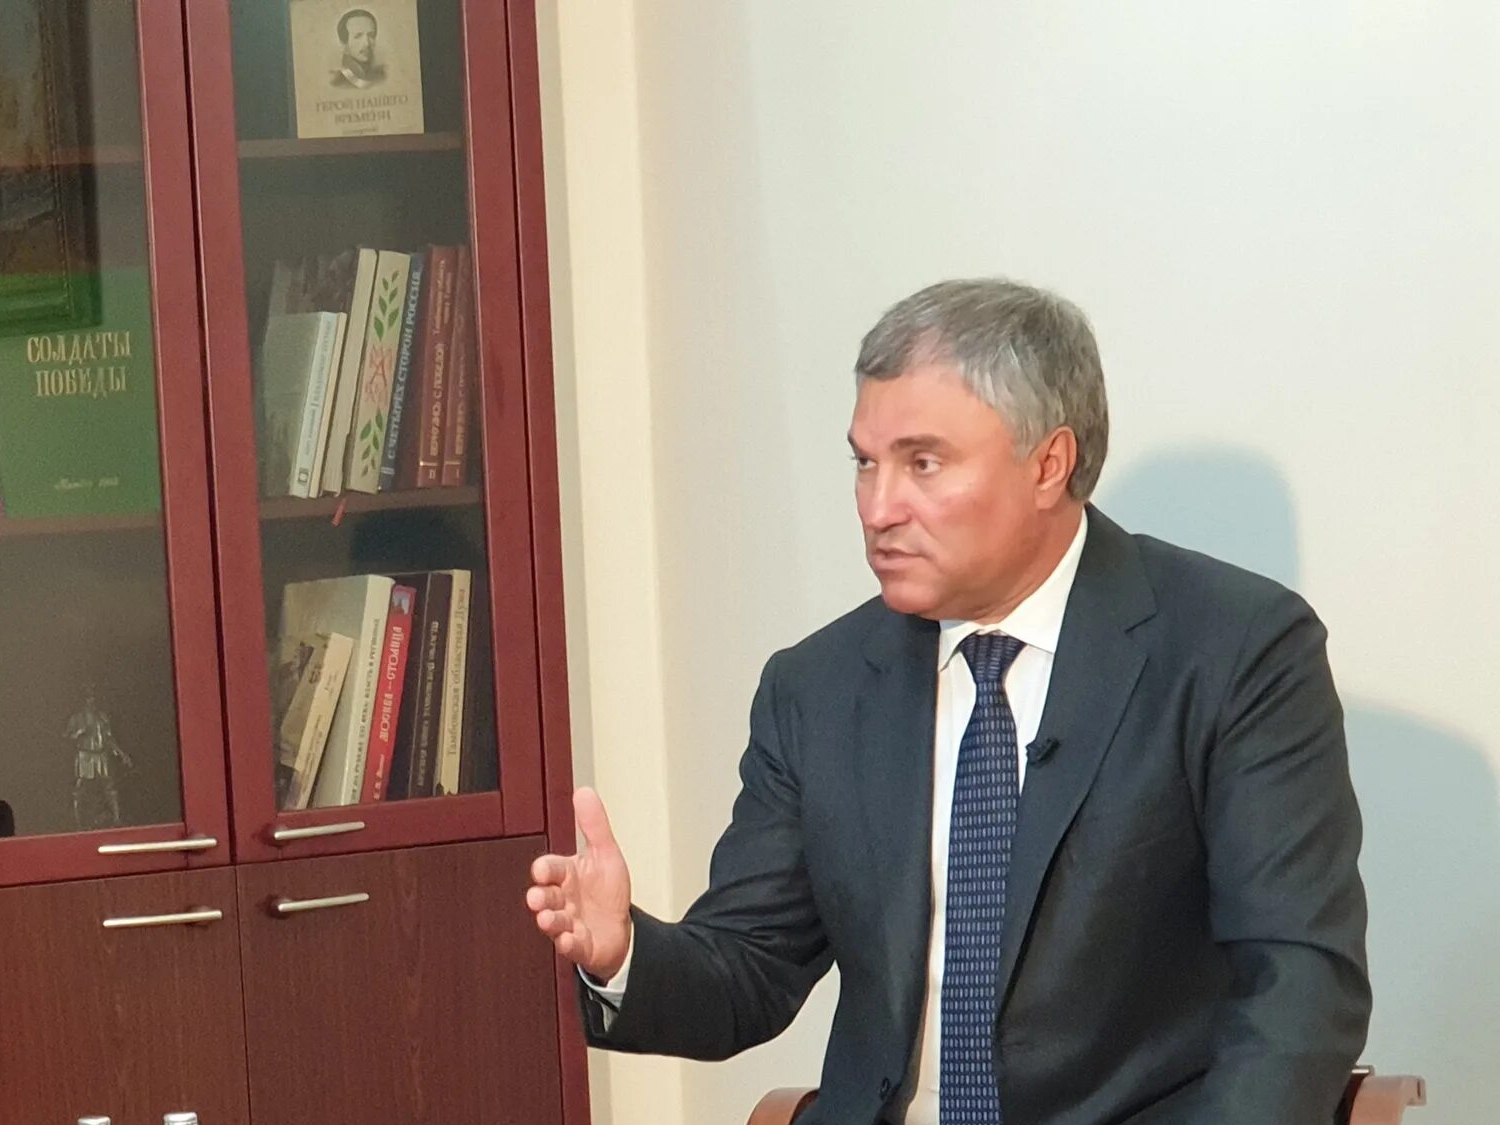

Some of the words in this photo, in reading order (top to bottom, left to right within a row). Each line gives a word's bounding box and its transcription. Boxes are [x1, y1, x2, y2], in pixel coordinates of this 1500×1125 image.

[27, 331, 132, 365] СОЛДАТЫ
[397, 327, 413, 381] СТОРОН
[35, 366, 128, 399] ПОБЕДЫ
[454, 588, 466, 621] Дума
[452, 623, 464, 684] областная
[379, 692, 394, 742] МОСКВА
[387, 625, 403, 680] СТОЛИЦА
[448, 687, 459, 757] Тамбовская
